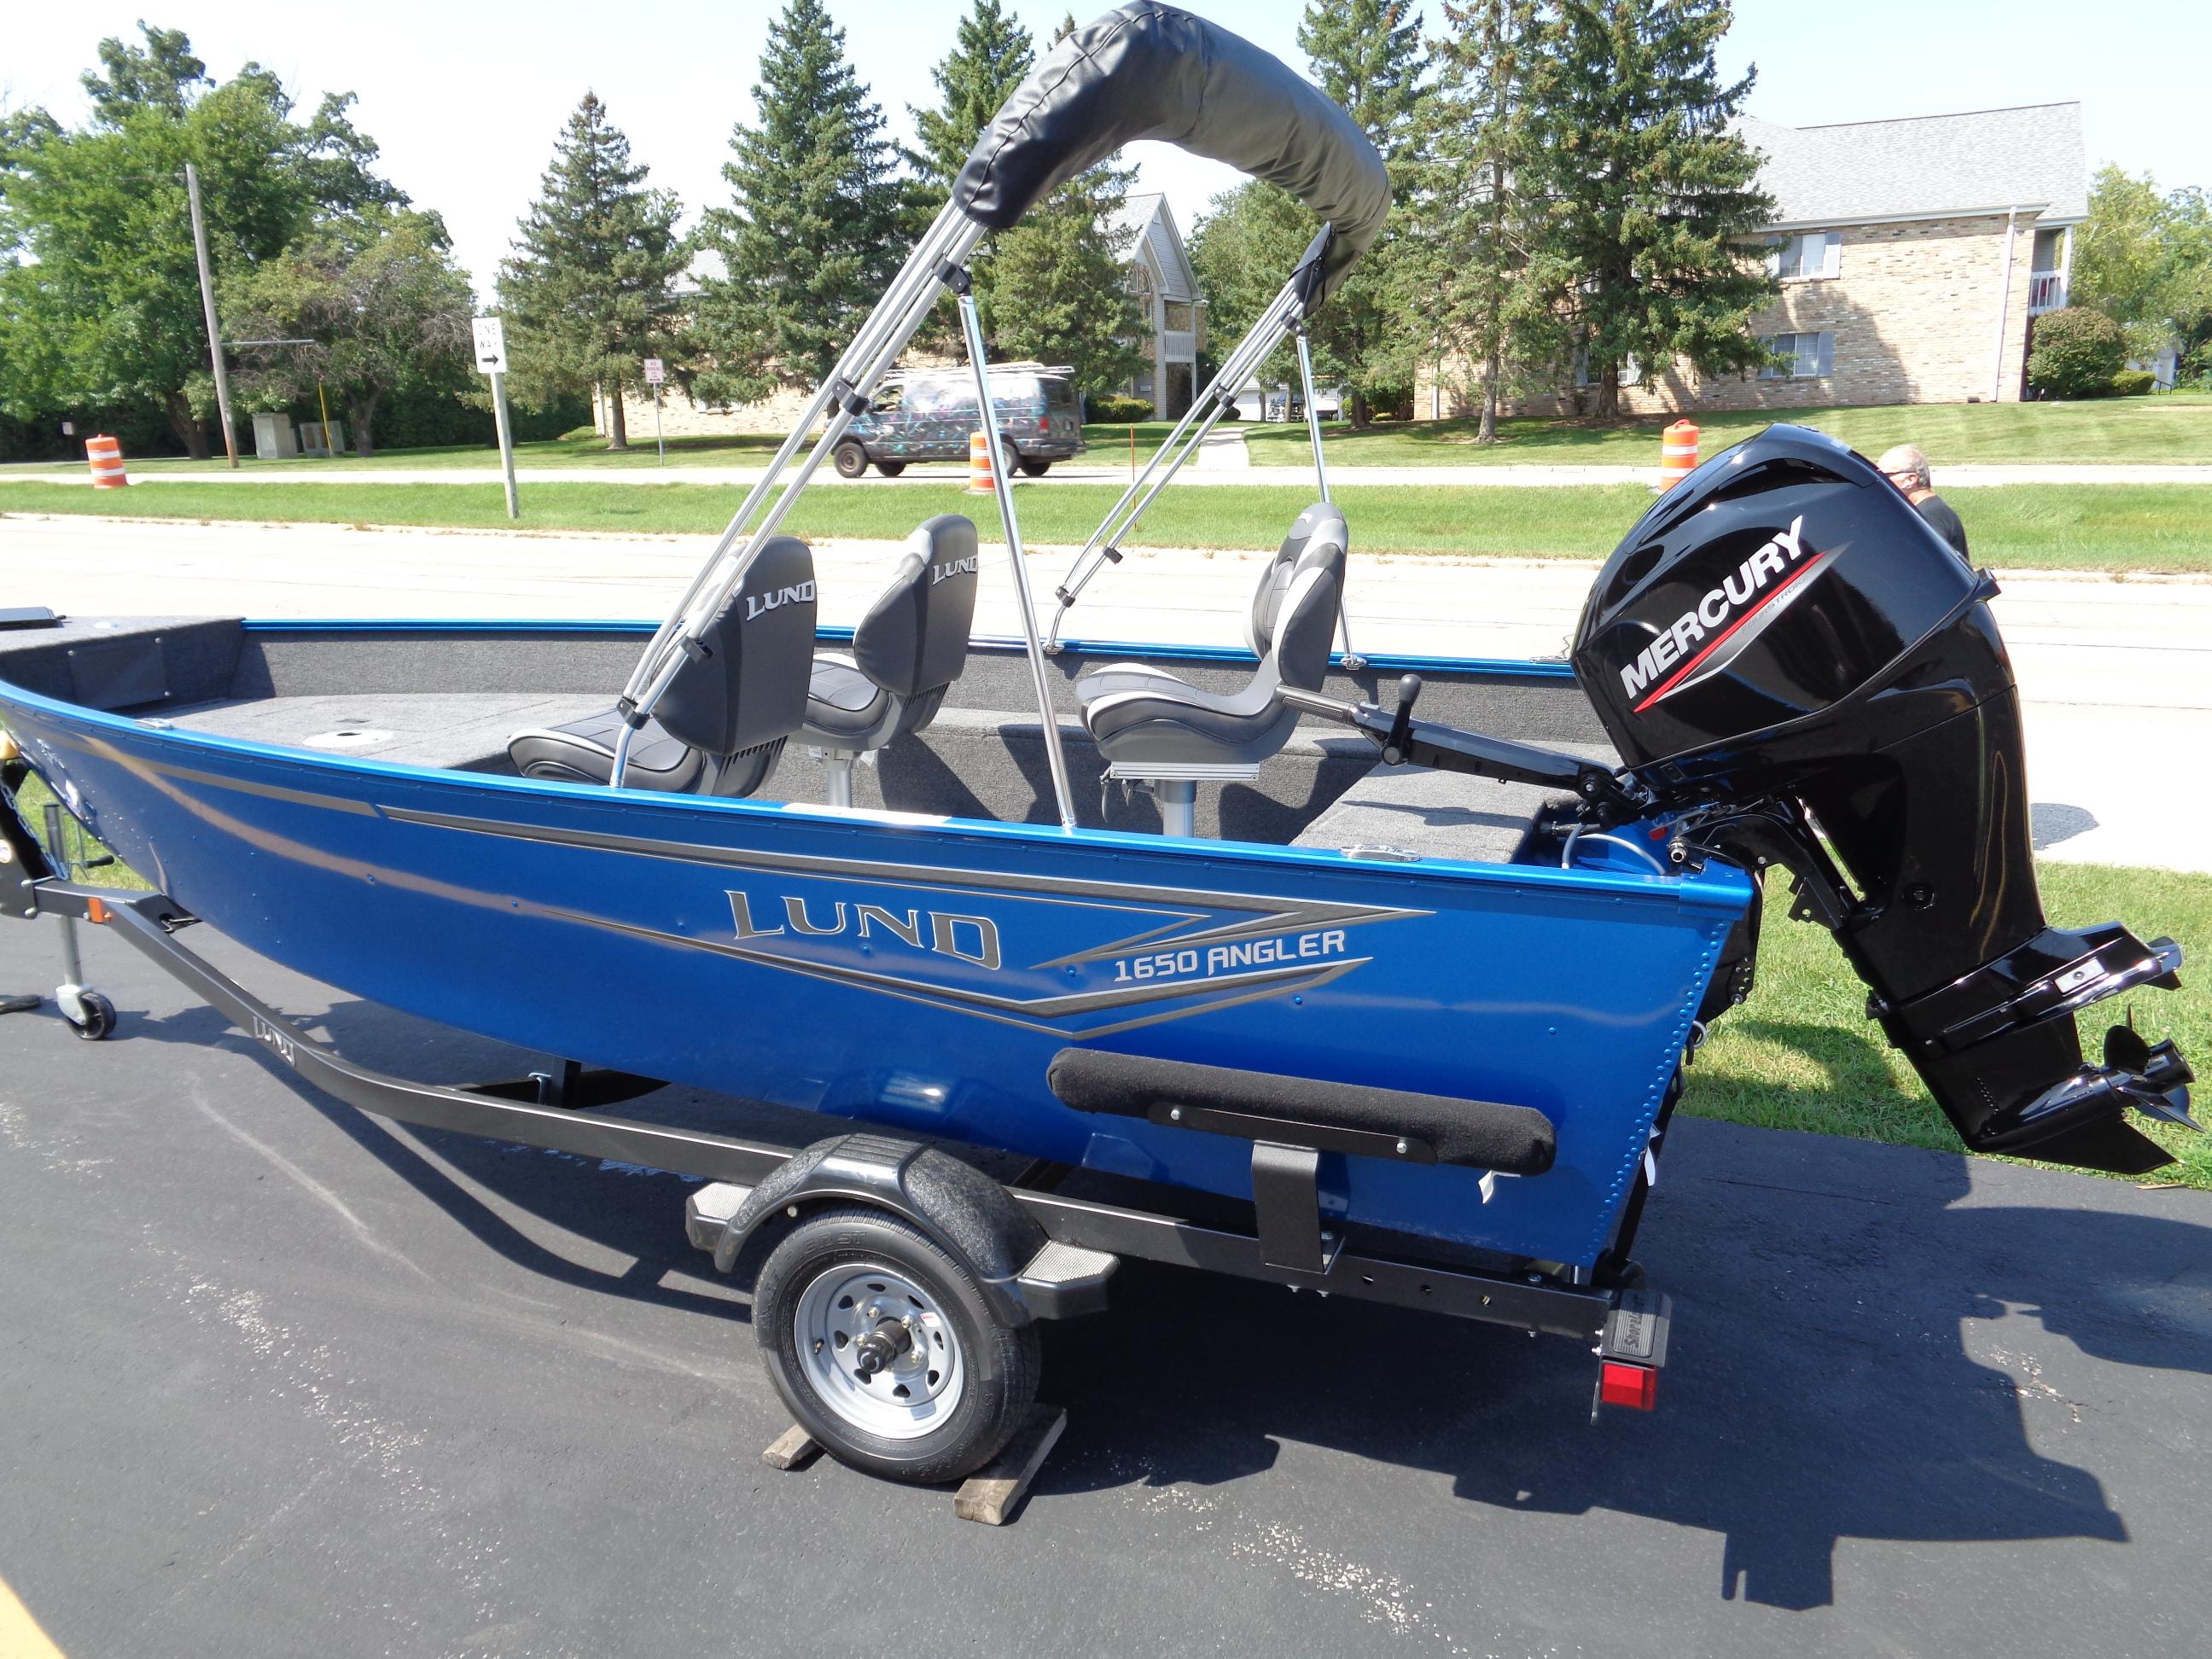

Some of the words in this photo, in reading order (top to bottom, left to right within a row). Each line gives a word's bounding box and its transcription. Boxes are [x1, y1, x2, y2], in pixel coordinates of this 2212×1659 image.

[933, 554, 978, 585] LUND
[746, 579, 816, 621] LUND
[1620, 515, 1803, 700] MERCURY
[724, 890, 1001, 970] LUND
[1114, 950, 1198, 982] 1650
[1208, 929, 1345, 976] ANGLER
